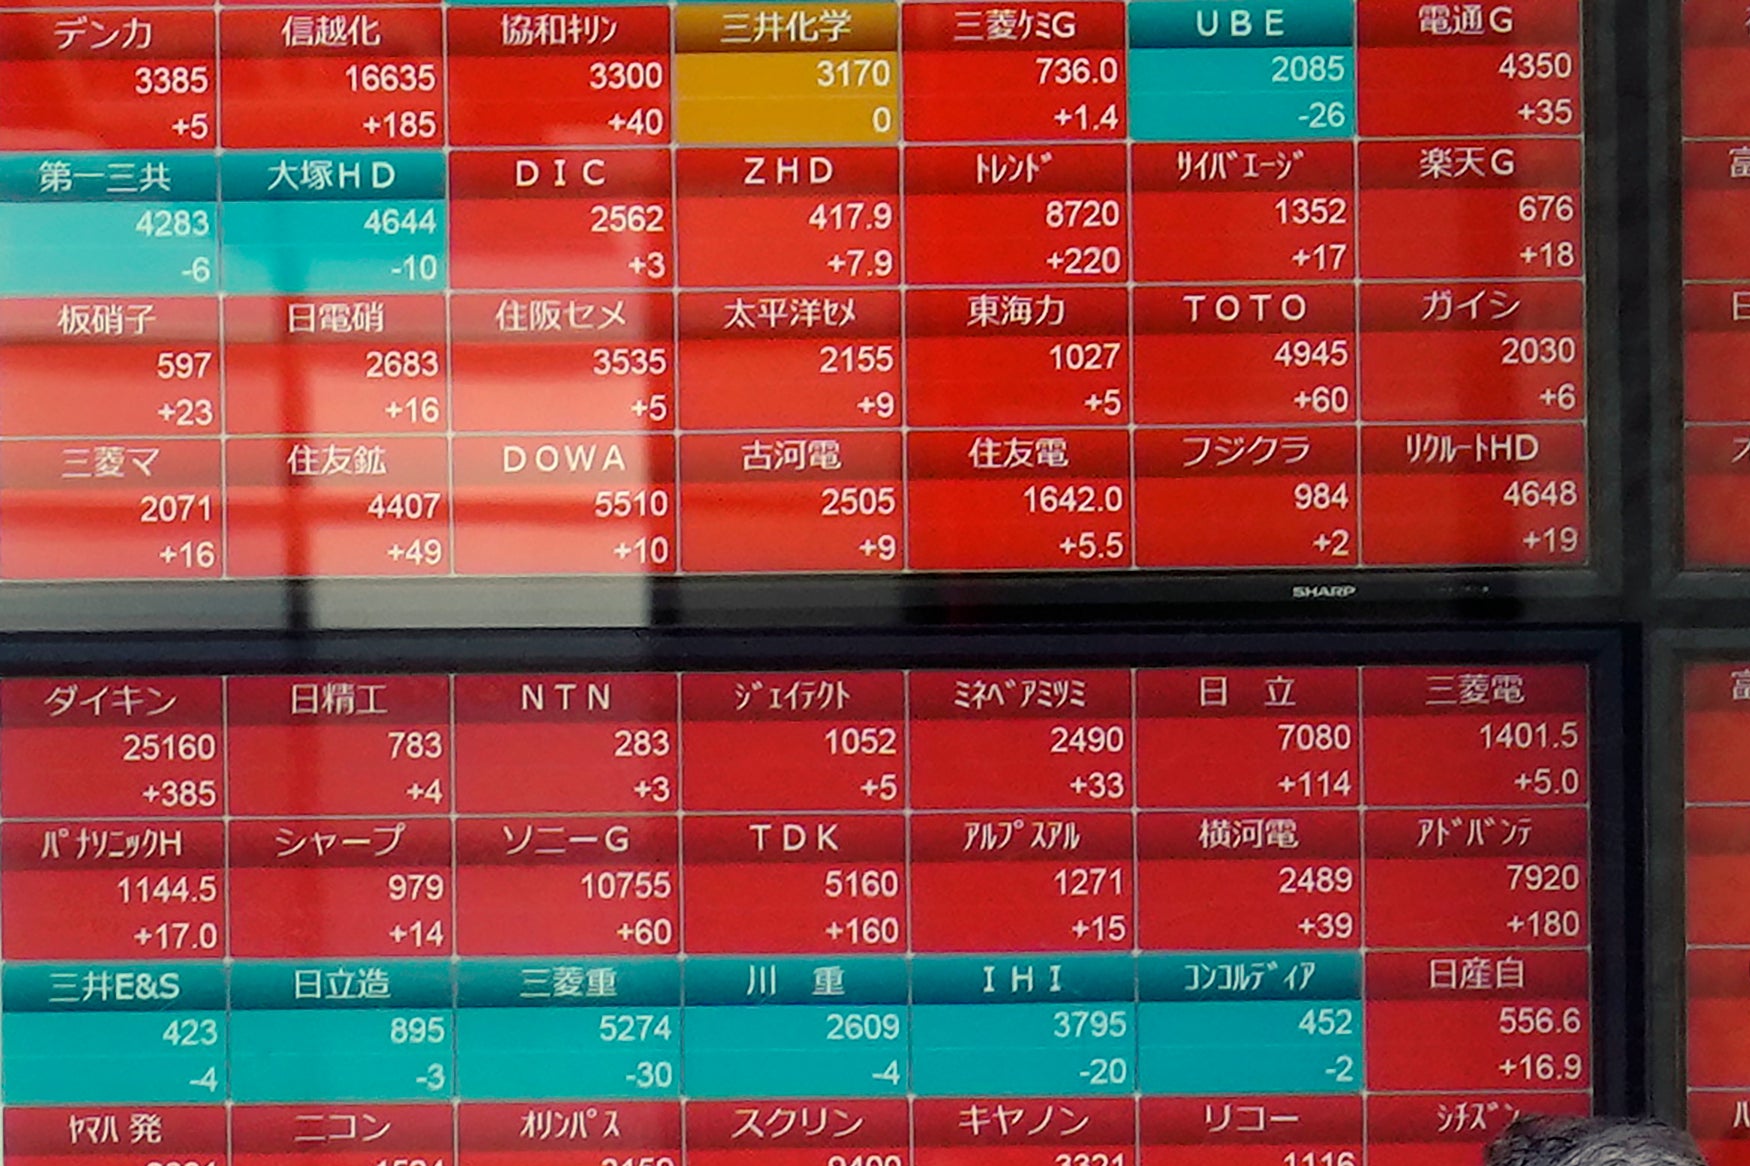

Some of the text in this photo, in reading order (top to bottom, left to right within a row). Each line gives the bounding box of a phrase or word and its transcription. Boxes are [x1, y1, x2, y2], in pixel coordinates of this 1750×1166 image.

[53, 14, 152, 50] デンカ
[280, 13, 382, 48] 信越化
[719, 9, 853, 44] 三井化学
[134, 65, 209, 95] 3385
[344, 63, 437, 93] 16635
[815, 58, 892, 88] 3170
[1497, 51, 1573, 80] 4350
[171, 111, 210, 141] +5
[362, 109, 437, 139] +185
[871, 105, 893, 134] 0
[1516, 97, 1574, 126] +35
[38, 160, 172, 193] 第一三共
[1517, 193, 1575, 223] 676
[134, 210, 210, 238] 4283
[180, 254, 211, 284] -6
[1518, 240, 1576, 268] +18
[56, 303, 157, 337] 板硝子
[494, 298, 627, 333] 住阪セメ
[157, 351, 213, 380] 597
[593, 347, 668, 376] 3535
[156, 397, 214, 427] +23
[630, 393, 668, 422] +5
[286, 442, 388, 476] 住友鉱
[967, 436, 1070, 470] 住友電
[1182, 435, 1311, 468] フジクラ
[367, 491, 442, 520] 4407
[1023, 484, 1124, 514] 1642.0
[1293, 481, 1350, 511] 984
[384, 536, 443, 568] +49
[1058, 530, 1125, 560] +5.5
[1312, 528, 1350, 557] +2
[1292, 585, 1356, 598] SHARP
[43, 683, 178, 717] ダイキン
[1424, 672, 1526, 706] 三菱電
[122, 732, 217, 762] 25160
[1479, 720, 1579, 750] 1401.5
[141, 779, 217, 808] +385
[1513, 766, 1580, 796] +5.0
[1197, 817, 1300, 850] 横河電
[580, 870, 673, 900] 10755
[1278, 865, 1354, 895] 2489
[616, 917, 673, 946] +60
[1297, 911, 1354, 940] +39
[518, 965, 618, 999] 三菱重
[1429, 957, 1525, 990] 日産自
[161, 1017, 219, 1047] 423
[598, 1013, 673, 1043] 5274
[1498, 1005, 1582, 1035] 556.6
[188, 1065, 220, 1093] -4
[624, 1060, 674, 1089] -30
[1498, 1052, 1583, 1081] +16.9
[293, 1112, 392, 1142] ニコン
[958, 1103, 1090, 1137] キヤノン
